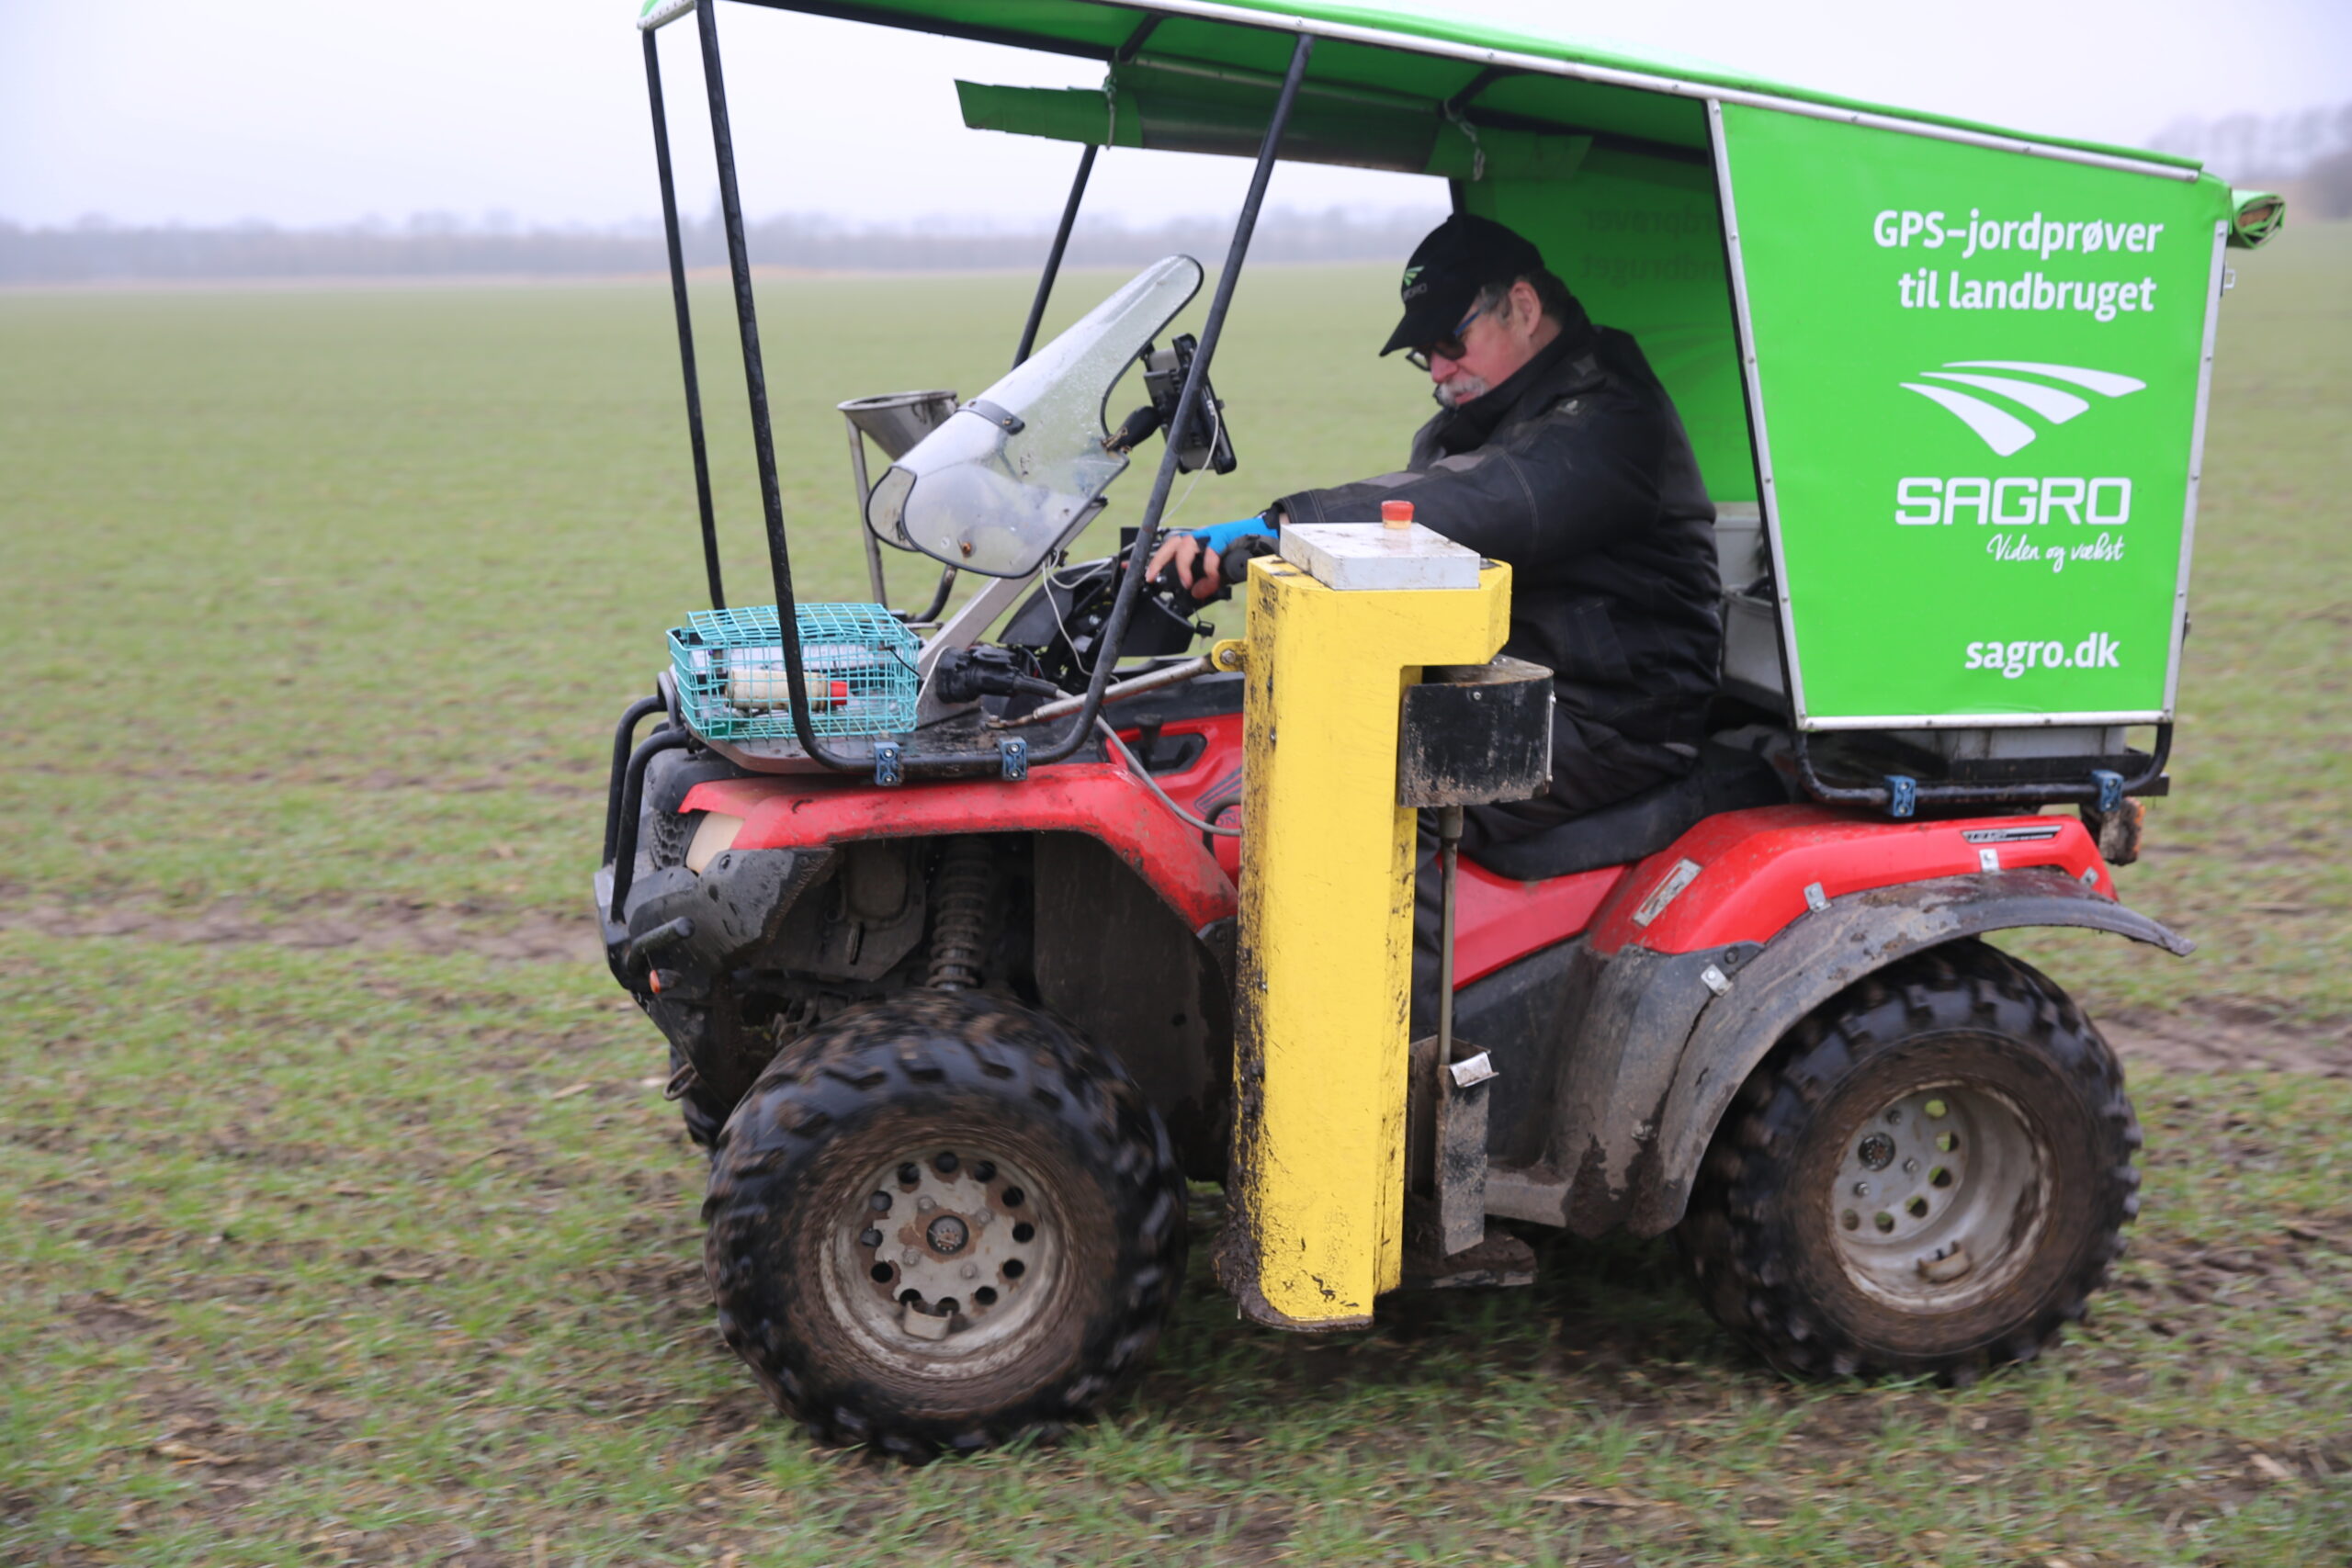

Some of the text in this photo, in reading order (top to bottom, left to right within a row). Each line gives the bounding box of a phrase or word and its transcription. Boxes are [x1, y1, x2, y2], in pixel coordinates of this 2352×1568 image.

[1873, 208, 2165, 261] GPS-jordprøver
[1898, 267, 2157, 322] til landbruget
[1894, 477, 2132, 525] SAGRO
[1986, 532, 2125, 573] Viden og vækst
[1964, 632, 2120, 679] sagro.dk
